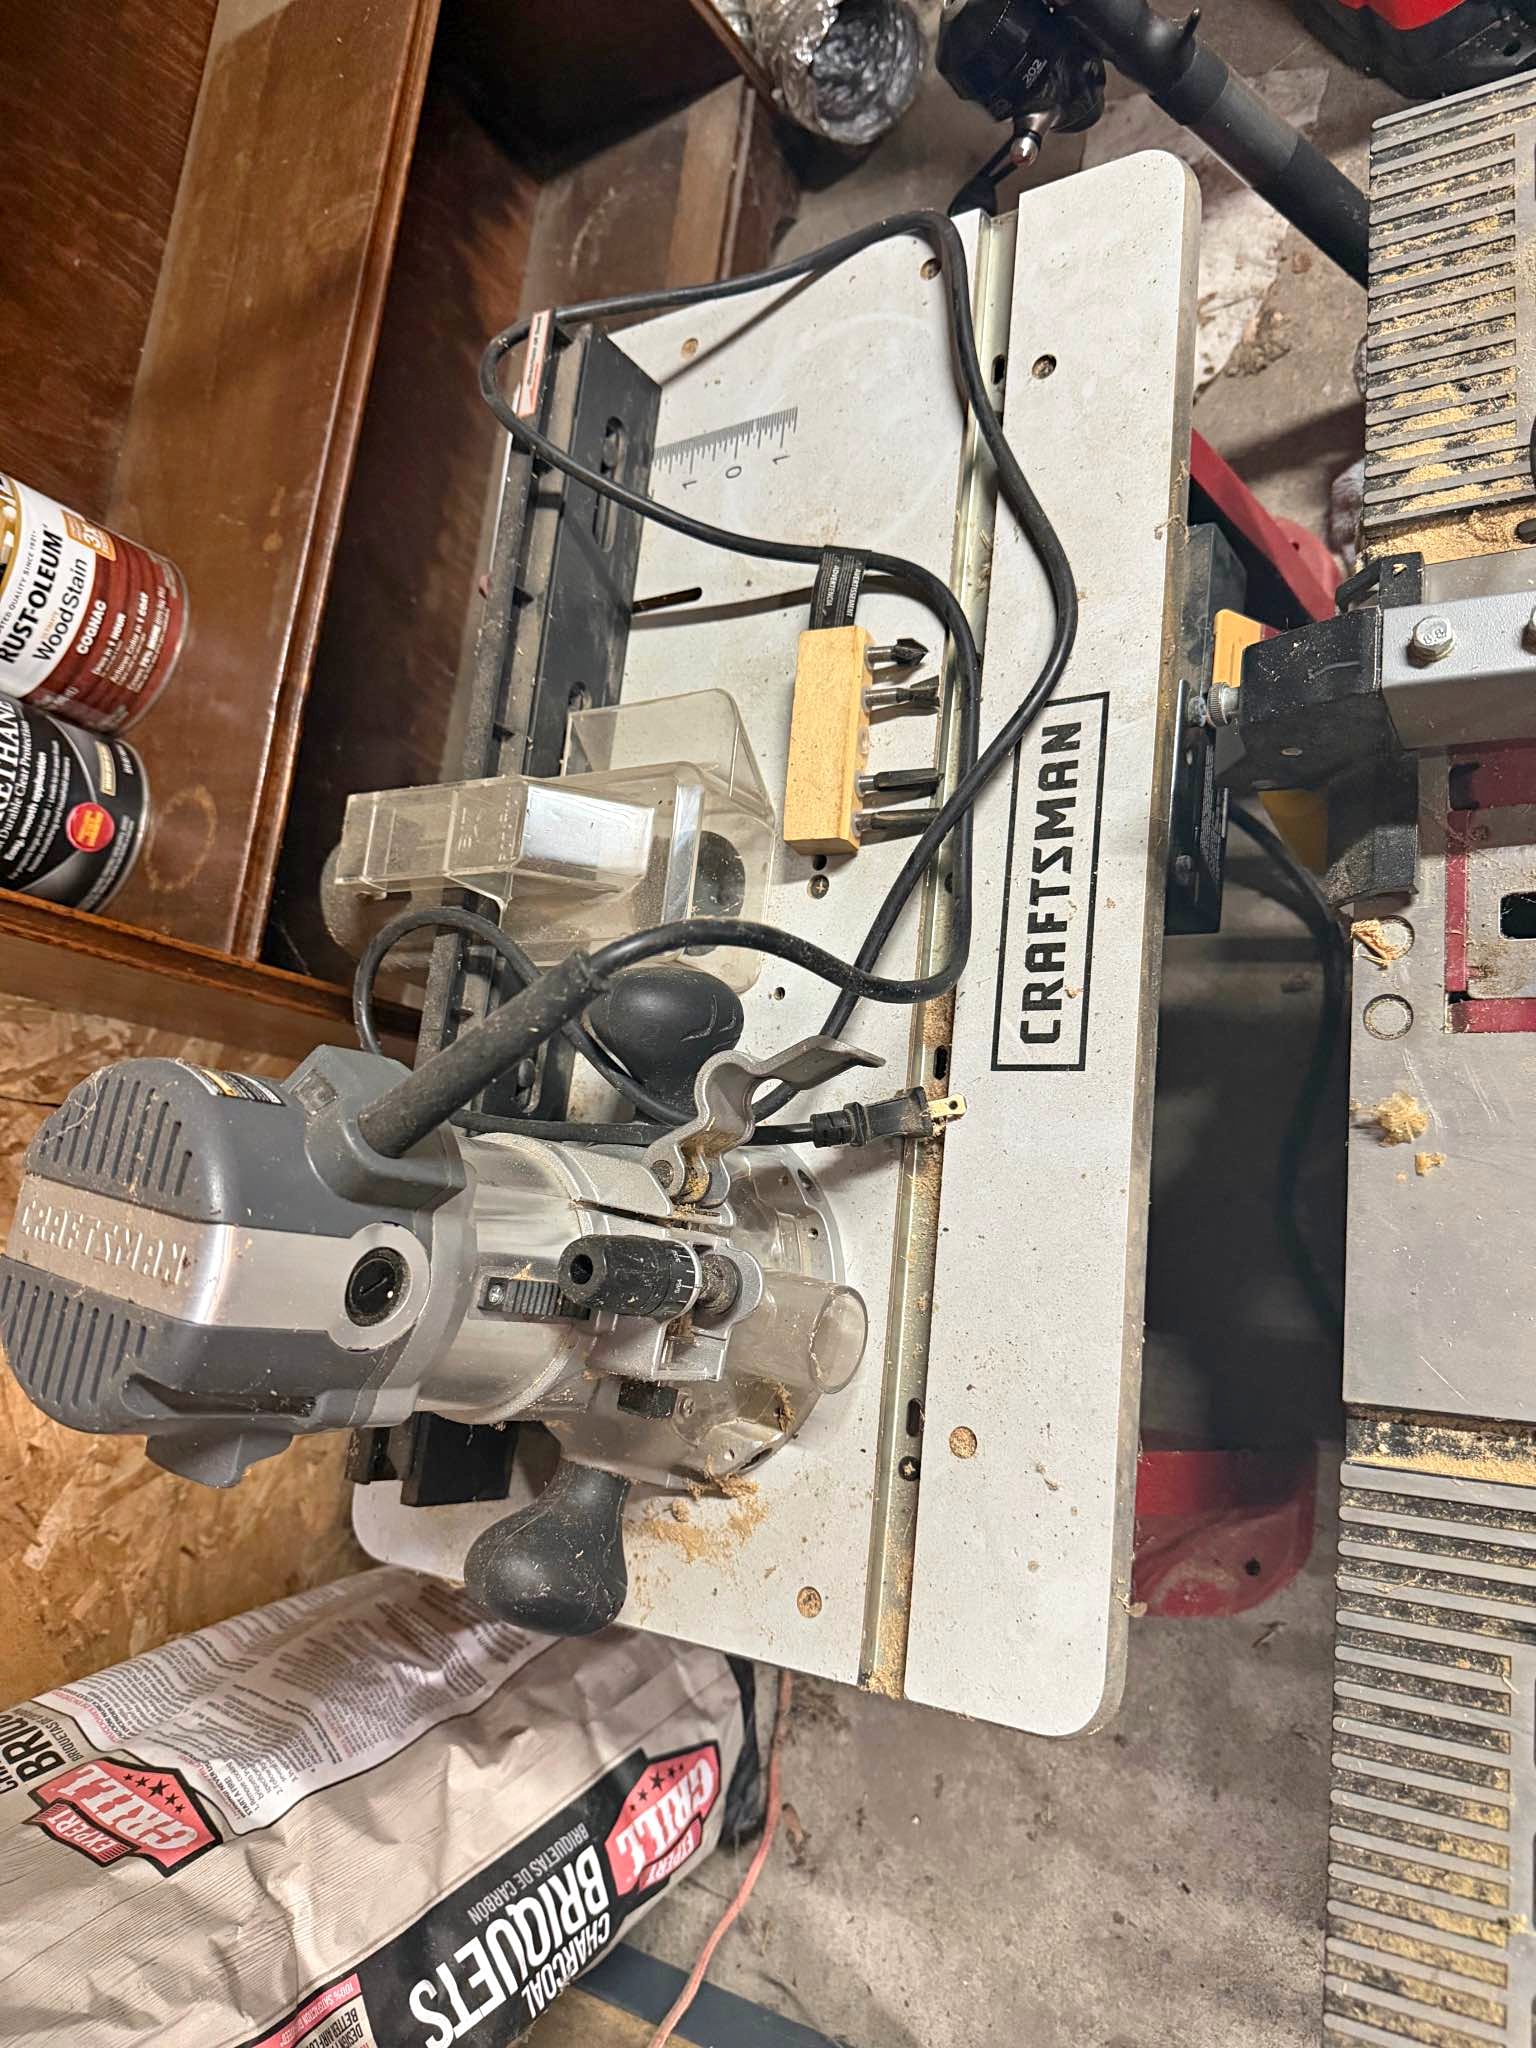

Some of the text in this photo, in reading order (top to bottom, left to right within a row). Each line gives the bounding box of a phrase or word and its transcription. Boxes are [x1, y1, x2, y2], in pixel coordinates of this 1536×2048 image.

[682, 479, 698, 491] 1
[725, 465, 742, 479] 0
[772, 453, 791, 466] 1
[0, 531, 63, 665] RUST-OLEUM
[9, 577, 27, 611] QUALITY
[24, 549, 35, 576] SINCE
[826, 565, 840, 607] ADVERTENCIA
[846, 568, 861, 617] AVERTISSEMENT
[76, 600, 107, 655] COGNAC
[1, 719, 32, 839] Durable Clear Protection
[18, 802, 39, 838] smooth
[32, 752, 47, 803] application
[1020, 721, 1082, 1044] CRAFTSMAN
[46, 1722, 84, 1762] BRIQUETAS
[47, 1808, 115, 1854] EXPERT
[58, 1764, 199, 1850] GRILL
[237, 1799, 253, 1816] START
[615, 1758, 715, 1877] GRILL
[467, 1822, 590, 1926] BRIQUETAS DE CARBÓN
[646, 1828, 695, 1885] EXPERT
[409, 1844, 610, 2048] BRIQUETS
[521, 1912, 611, 2019] CHARCOAL
[301, 1982, 354, 2024] 100% SATISFACTION
[333, 2007, 359, 2035] BETTER
